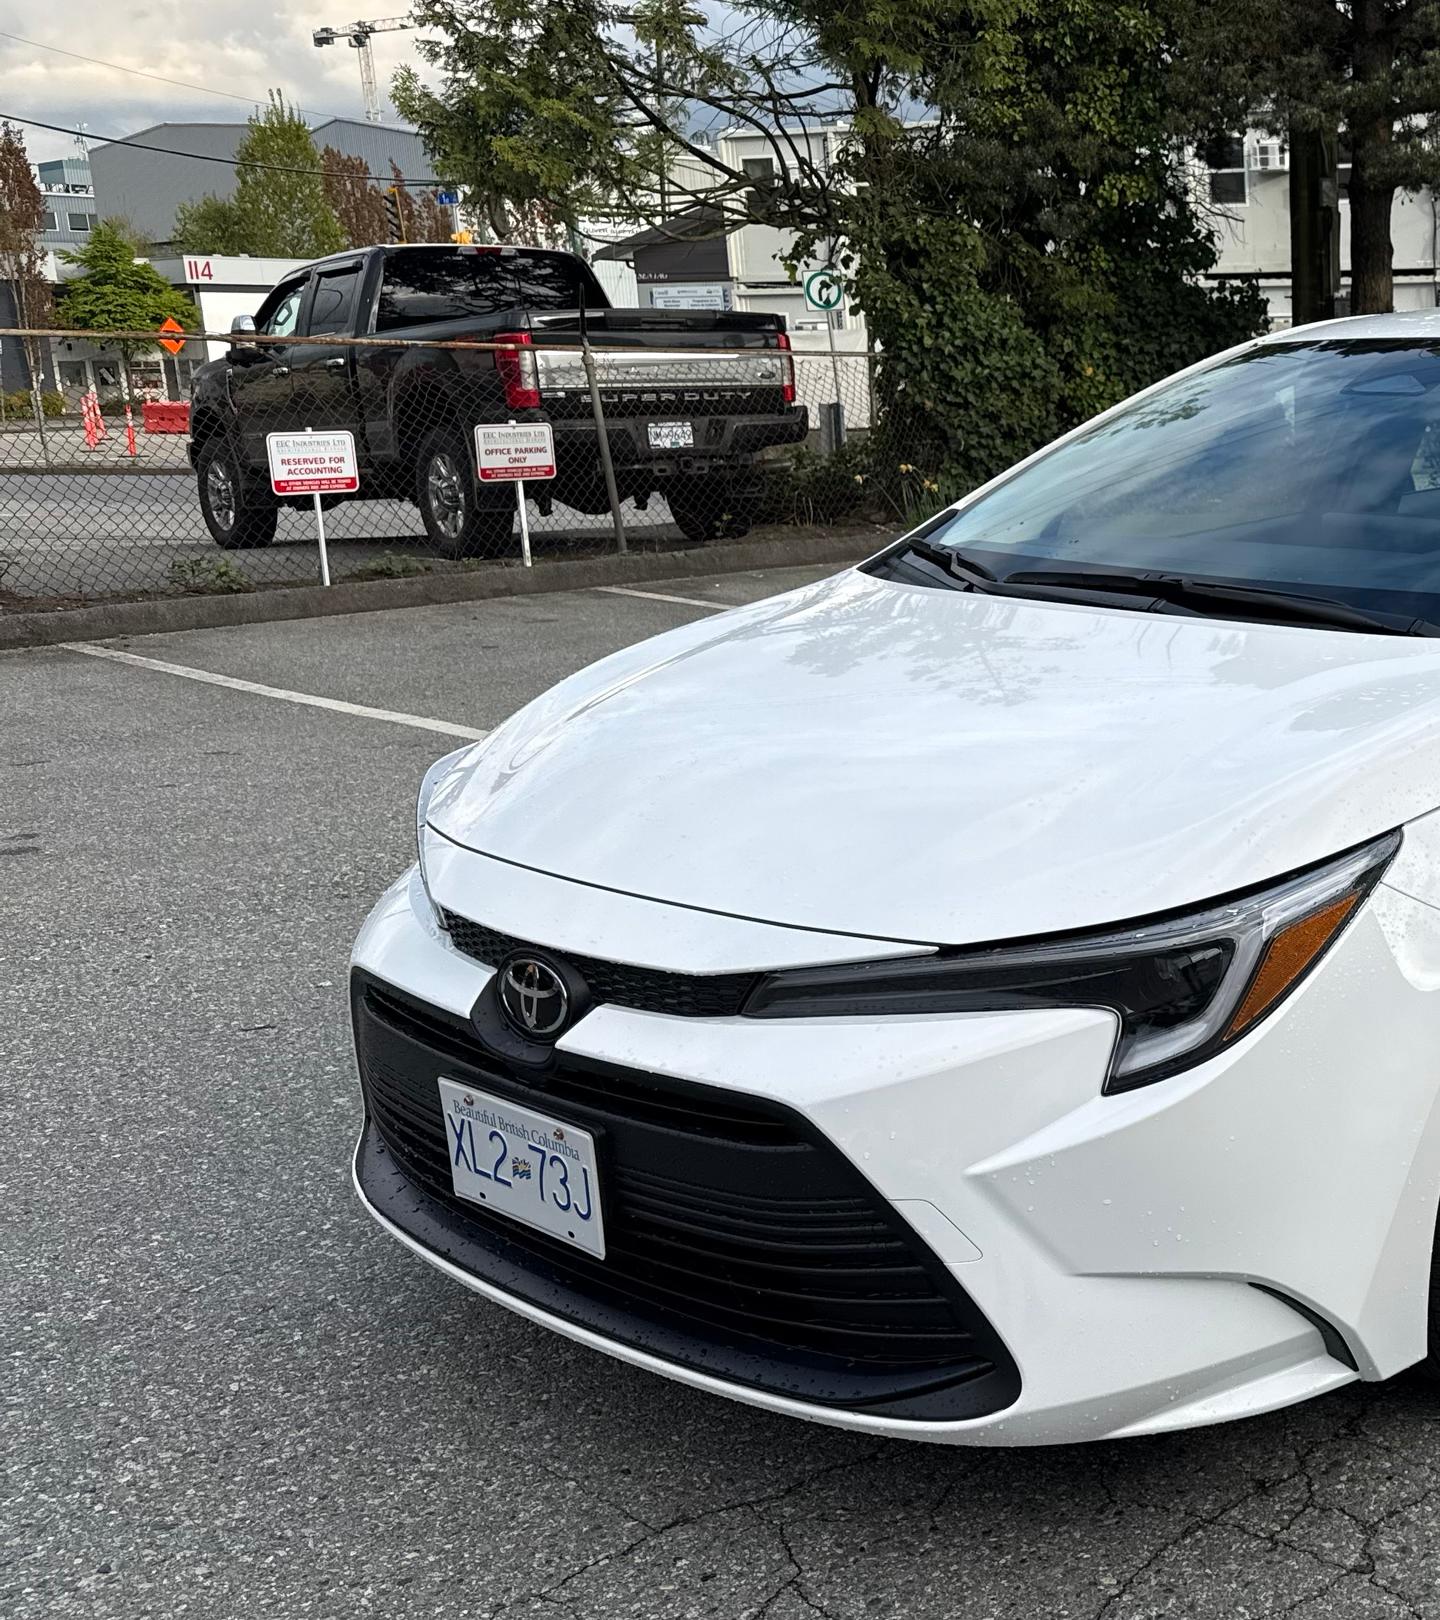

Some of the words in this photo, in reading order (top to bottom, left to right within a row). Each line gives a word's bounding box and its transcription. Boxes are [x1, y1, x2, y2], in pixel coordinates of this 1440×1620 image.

[189, 260, 213, 280] 114
[581, 392, 676, 402] SUPER
[684, 392, 751, 400] DUTY
[484, 448, 512, 456] OFFICE
[514, 446, 548, 455] PARKING
[281, 457, 326, 466] RESERVED
[329, 456, 346, 464] FOR
[508, 456, 527, 464] ONLY
[287, 466, 343, 476] ACCOUNTING
[453, 1101, 497, 1131] Beautiful
[498, 1116, 530, 1141] British
[531, 1129, 580, 1161] Columbia
[447, 1113, 512, 1188] XL2
[528, 1143, 592, 1221] 73J
